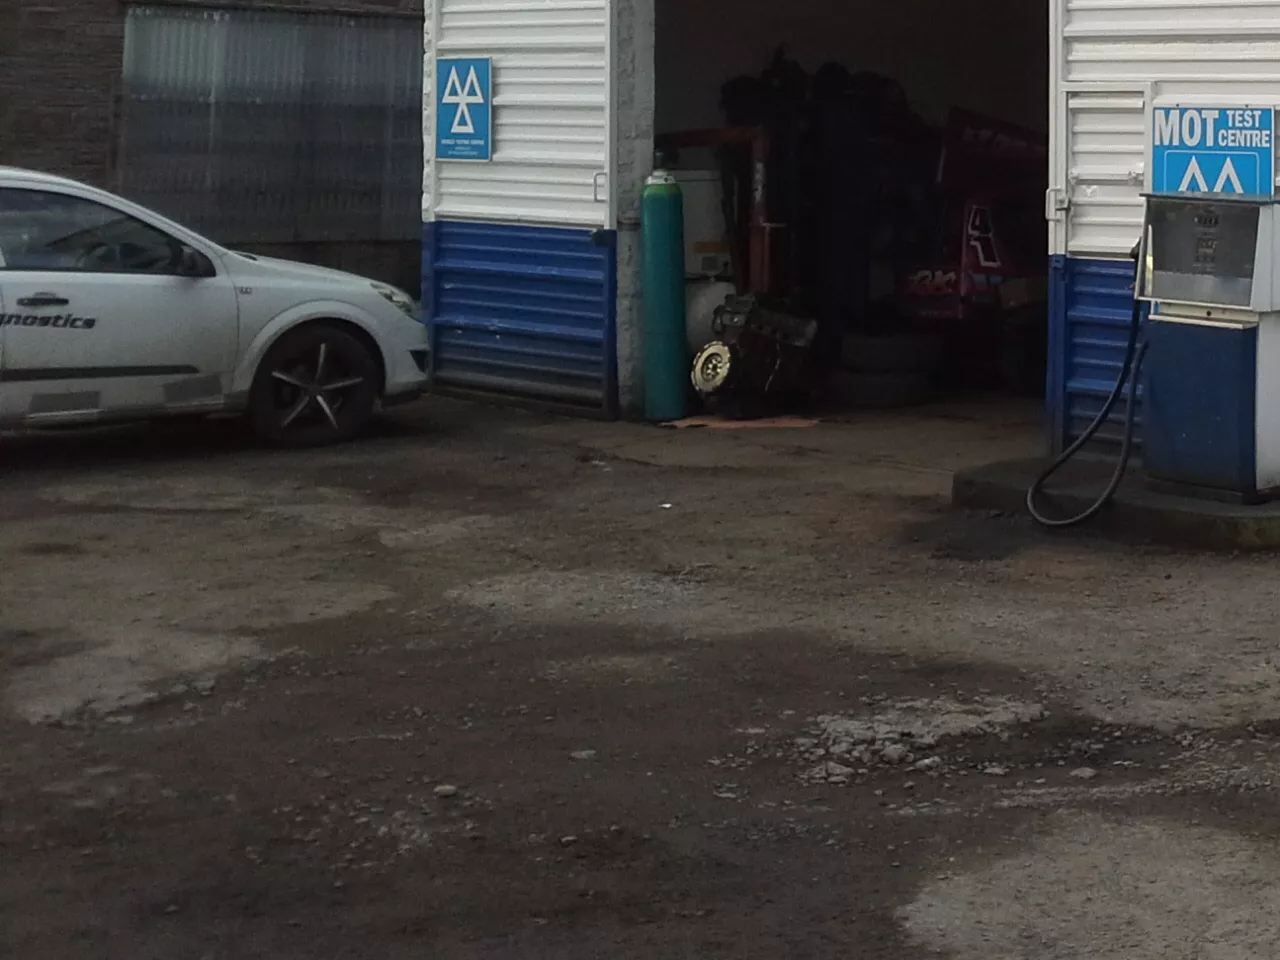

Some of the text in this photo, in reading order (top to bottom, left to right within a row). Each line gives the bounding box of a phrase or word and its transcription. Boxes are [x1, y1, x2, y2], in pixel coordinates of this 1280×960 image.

[1153, 109, 1219, 147] MOT
[1227, 110, 1262, 128] TEST
[1218, 129, 1271, 148] CENTRE
